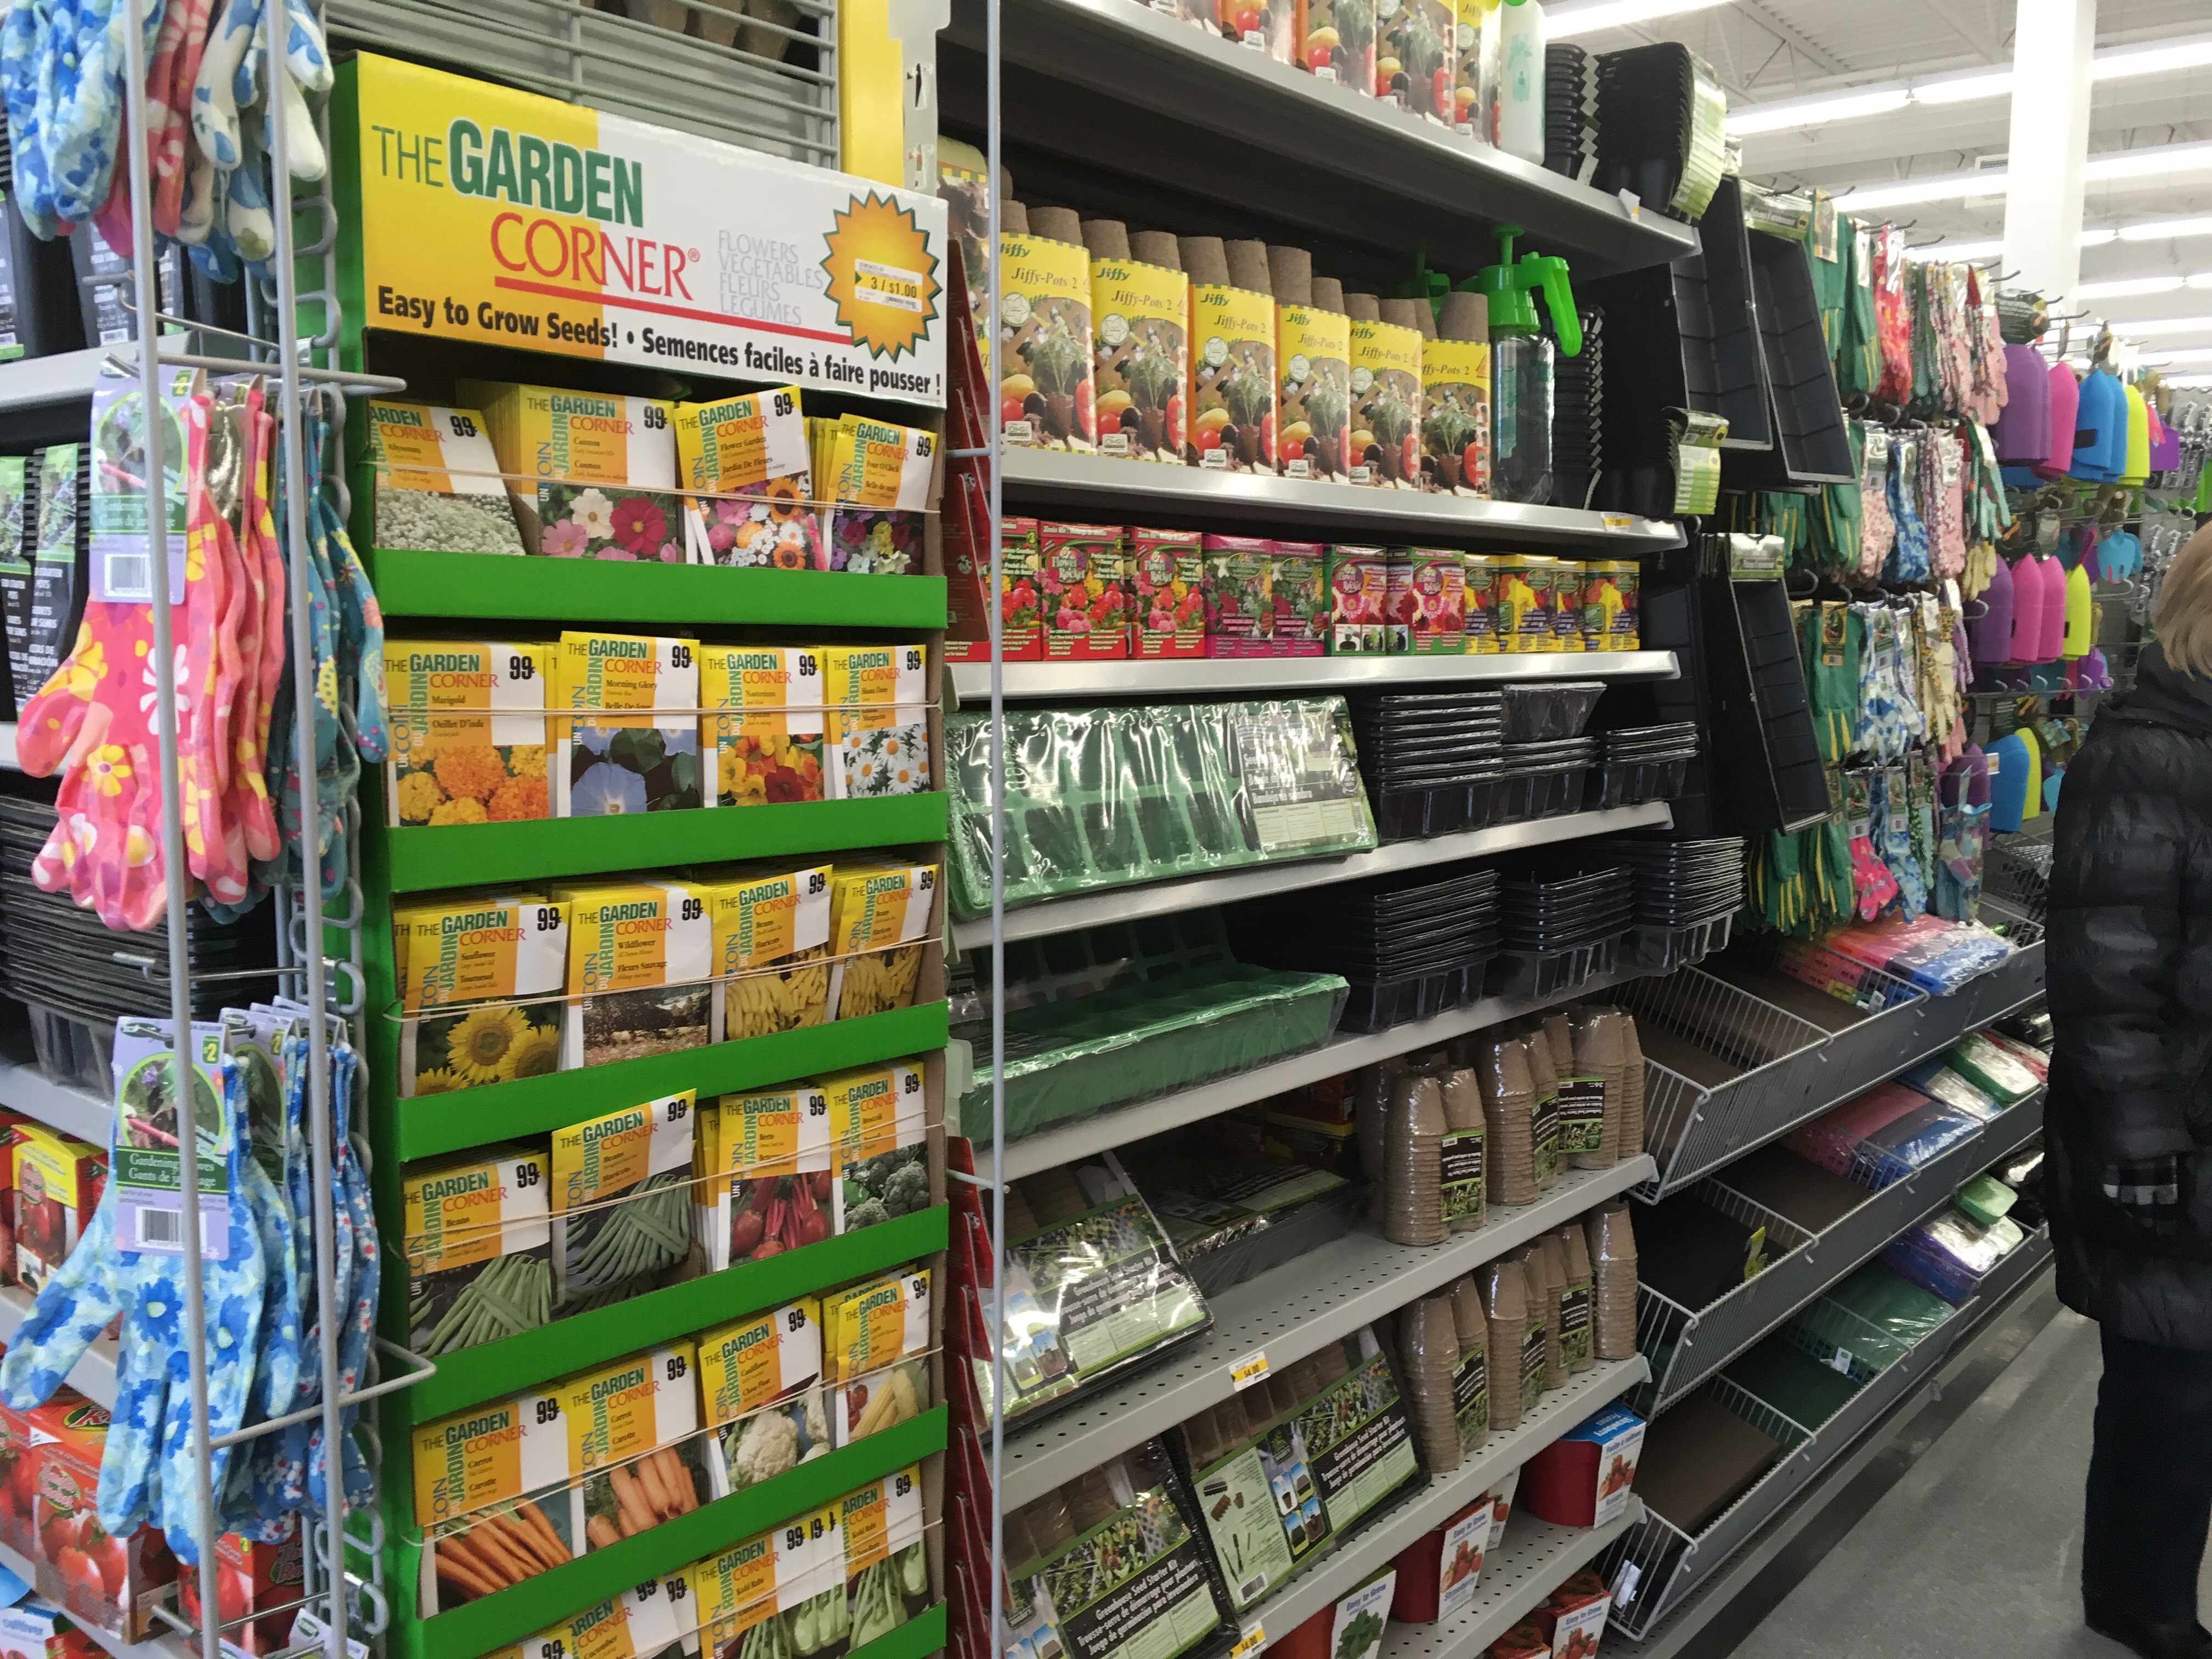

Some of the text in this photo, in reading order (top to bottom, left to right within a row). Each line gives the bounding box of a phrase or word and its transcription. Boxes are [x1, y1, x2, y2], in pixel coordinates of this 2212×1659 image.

[372, 119, 644, 228] THE GARDEN
[718, 230, 799, 264] FLOWERS
[718, 252, 824, 291] VEGETABLES
[1011, 267, 1077, 289] Jiffy-Pots 2
[1096, 268, 1131, 281] Jiffy
[718, 274, 781, 302] FLEURS
[871, 276, 877, 290] 3
[889, 283, 917, 298] $1.00
[719, 295, 802, 325] LEGUMES
[1111, 290, 1172, 310] Jiffy-Pots 2
[1200, 294, 1231, 307] Jiffy
[1214, 314, 1266, 334] Jiffy-Pots 2
[1286, 313, 1311, 326] Jiffy
[378, 286, 436, 321] Easy
[443, 294, 469, 325] to
[477, 302, 540, 336] Grow
[548, 318, 619, 349] Seeds!
[642, 330, 739, 367] Semences
[745, 342, 803, 377] faciles
[809, 351, 820, 377] à
[825, 354, 865, 386] faire
[869, 365, 932, 396] pousser
[1297, 333, 1336, 351] Jiffy-Pots
[1358, 346, 1408, 363] Jiffy-Pots 2
[1422, 363, 1469, 376] ffy-Pots 2
[550, 395, 616, 418] GARDEN
[679, 400, 753, 431] THE GARDEN
[379, 424, 446, 443] CORNER
[569, 415, 635, 435] CORNER
[716, 415, 769, 438] CORNER
[856, 422, 901, 445] GARDEN
[553, 411, 571, 473] JARDIN
[866, 442, 909, 461] CORNER
[855, 438, 867, 493] JARDIN
[588, 639, 647, 658] GARDEN
[848, 652, 890, 668] GARDEN
[385, 659, 408, 673] THE
[409, 653, 479, 672] GARDEN
[604, 658, 663, 674] CORNER
[707, 654, 777, 671] THE GARDEN
[430, 673, 500, 688] CORNER
[742, 672, 792, 684] CORNER
[860, 668, 901, 681] CORNER
[720, 880, 789, 910] THE GARDEN
[866, 874, 905, 895] GARDEN
[753, 894, 802, 916] CORNER
[876, 888, 913, 905] CORNER
[417, 923, 440, 936] THE
[441, 910, 508, 934] GARDEN
[600, 901, 658, 923] GARDEN
[459, 928, 527, 946] CORNER
[615, 918, 673, 935] CORNER
[739, 904, 753, 957] JARDIN
[439, 933, 458, 992] JARDIN
[725, 934, 738, 974] COIN
[833, 1079, 889, 1107] THE GARDEN
[859, 1092, 900, 1112] CORNER
[743, 1097, 791, 1114] GARDEN
[560, 1111, 643, 1149] THE GARDEN
[758, 1112, 804, 1127] CORNER
[600, 1122, 658, 1150] CORNER
[583, 1141, 599, 1191] JARDIN
[422, 1171, 489, 1202] GARDEN
[442, 1186, 509, 1212] CORNER
[845, 1287, 898, 1322] THE GARDEN
[868, 1299, 910, 1323] CORNER
[721, 1323, 770, 1358] GARDEN
[737, 1333, 785, 1364] CORNER
[572, 1367, 645, 1408] THE GARDEN
[607, 1380, 661, 1409] CORNER
[445, 1410, 510, 1445] GARDEN
[592, 1398, 609, 1454] JARDIN
[465, 1425, 528, 1454] CORNER
[848, 1497, 891, 1526] CORNER
[718, 1539, 766, 1575] GARDEN
[732, 1551, 781, 1582] CORNER
[577, 1606, 634, 1649] CORNER
